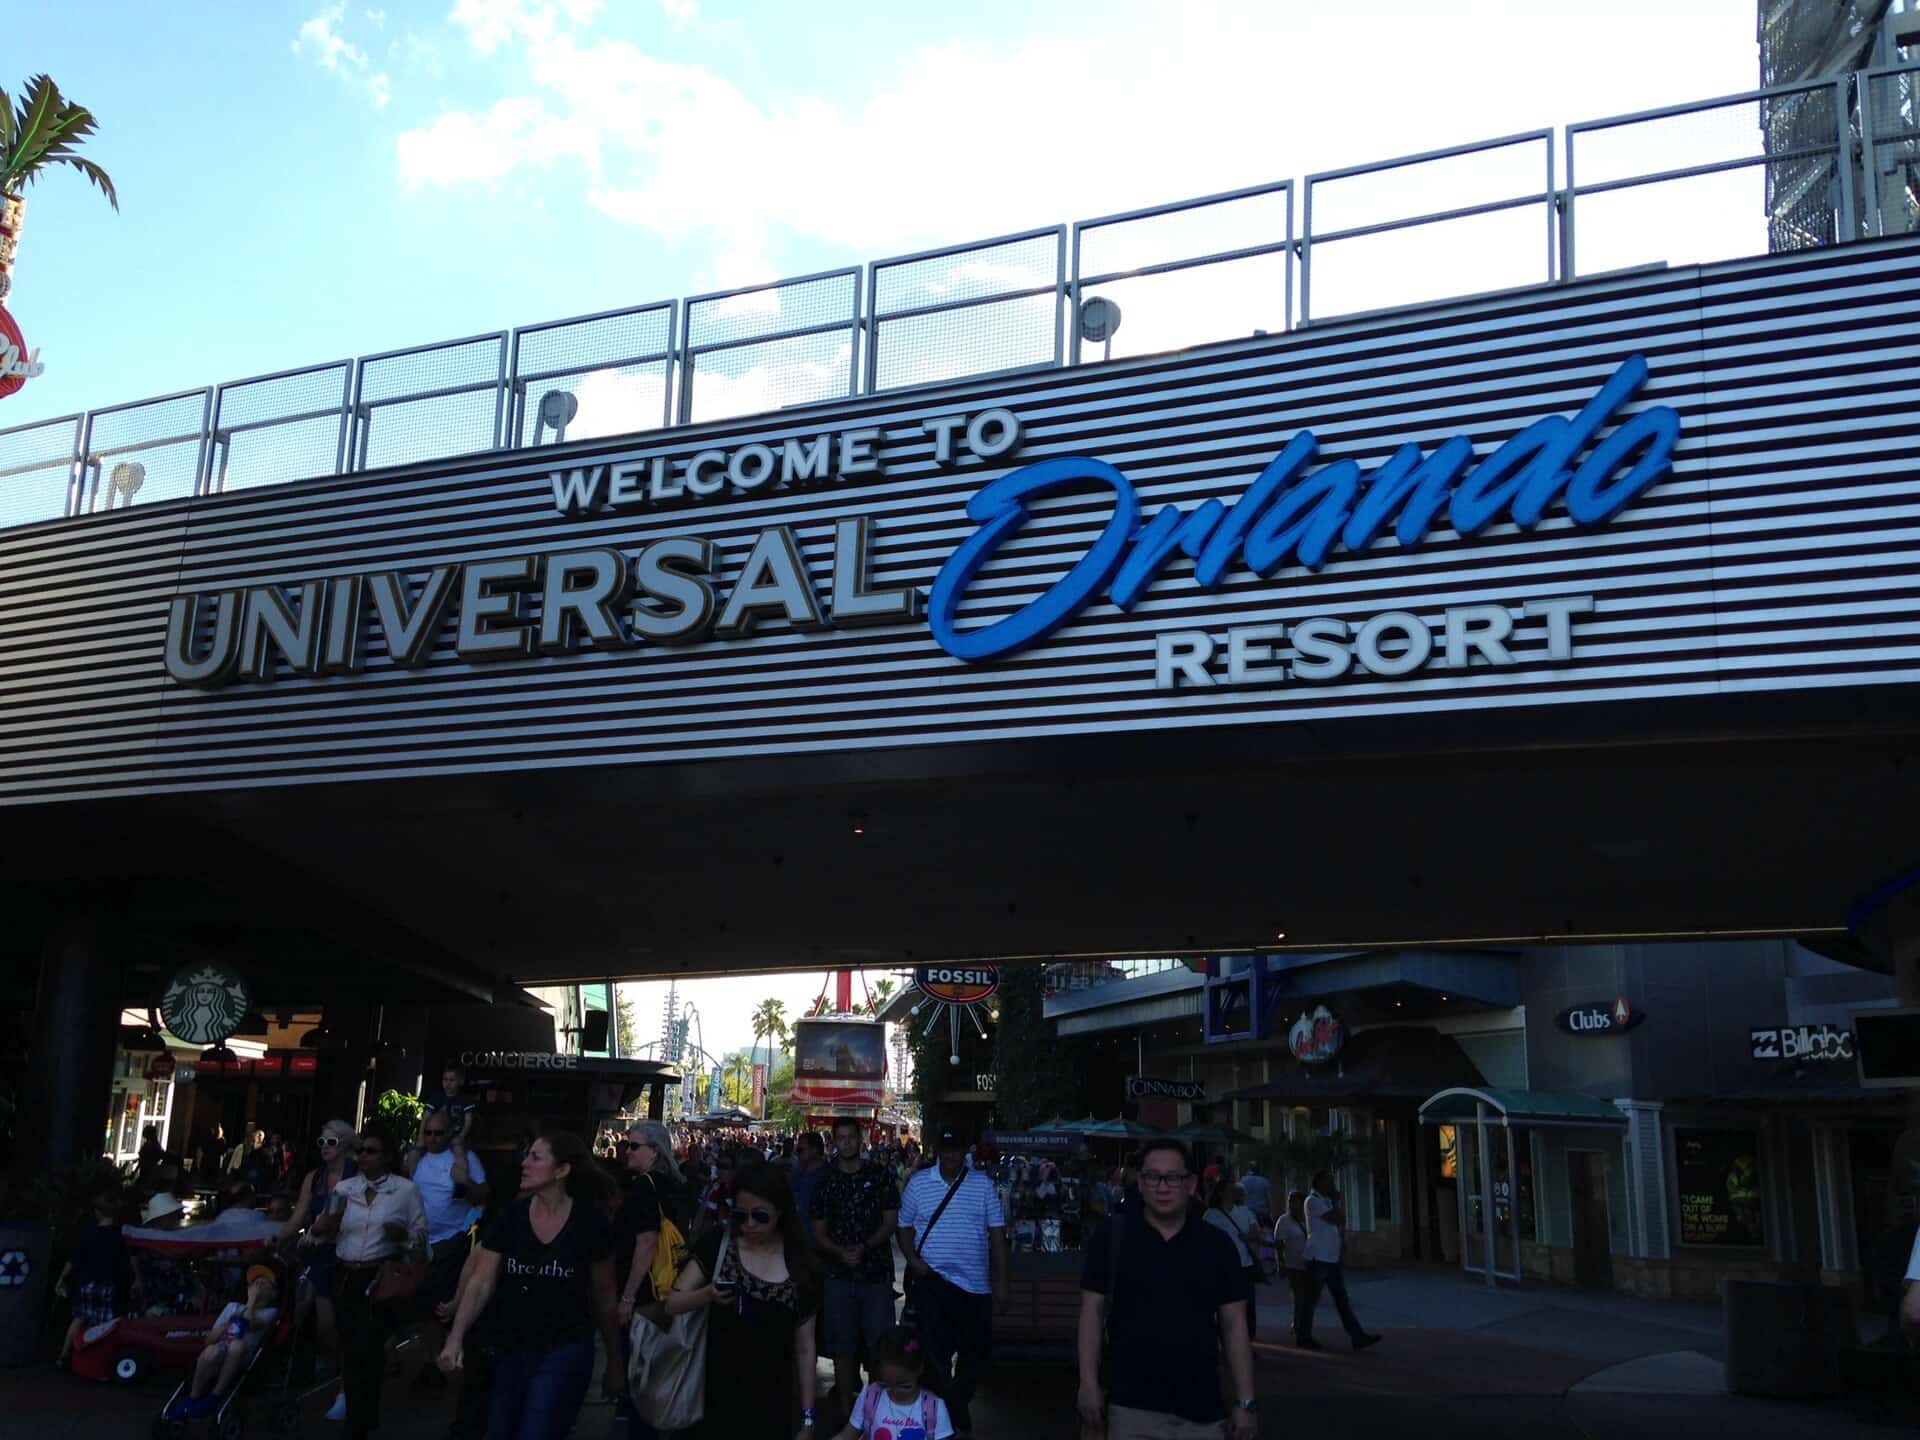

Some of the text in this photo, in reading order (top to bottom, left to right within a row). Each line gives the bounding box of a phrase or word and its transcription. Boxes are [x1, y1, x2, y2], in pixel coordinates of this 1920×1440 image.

[549, 407, 1024, 517] WELCOME TO
[163, 355, 1682, 690] UNIVERSAL Orlando
[1155, 595, 1596, 692] RESORT
[927, 968, 993, 985] FOSSIL
[1568, 1008, 1612, 1032] Clubs
[1780, 1025, 1854, 1060] Billabo
[459, 1049, 577, 1071] CONCIERGE
[1131, 1078, 1205, 1100] CINNABON
[506, 1257, 576, 1279] Breathe
